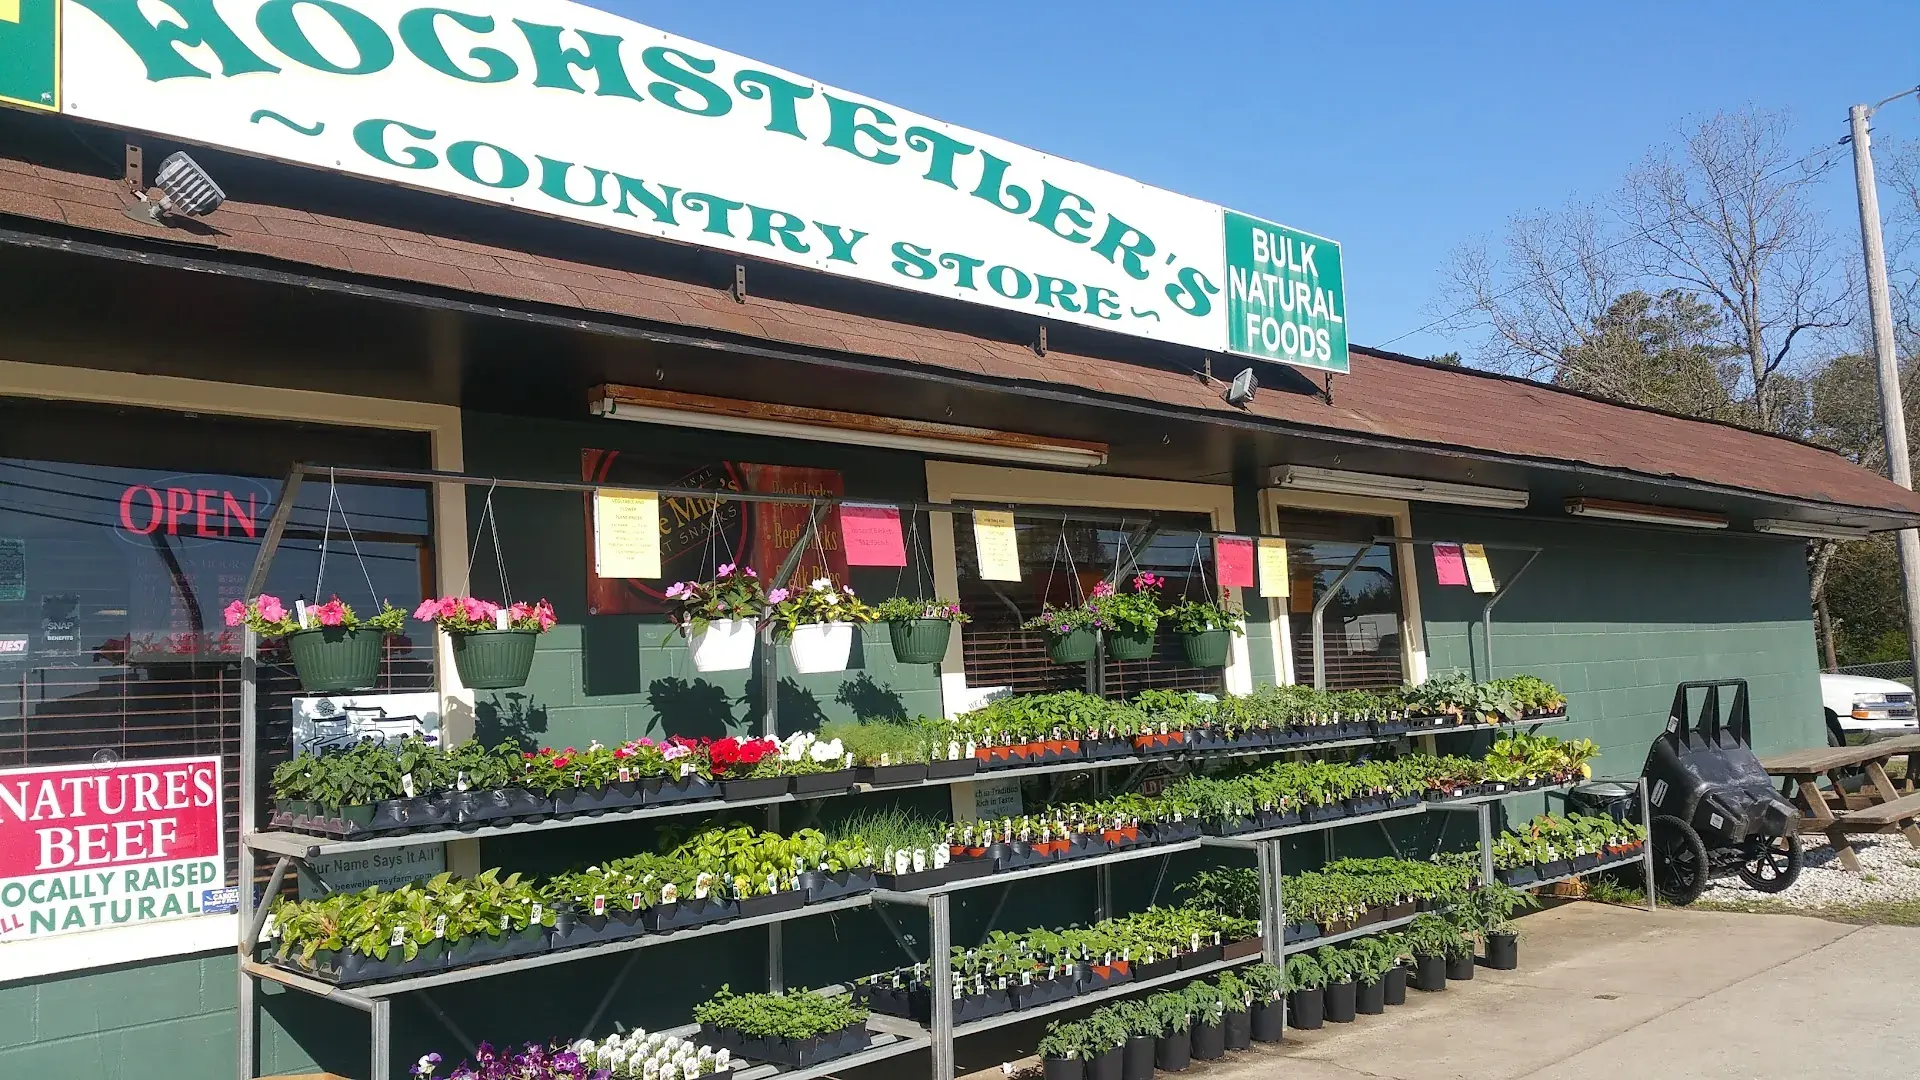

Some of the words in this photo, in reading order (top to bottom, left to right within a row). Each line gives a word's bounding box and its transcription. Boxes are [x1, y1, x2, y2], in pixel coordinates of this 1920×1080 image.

[66, 0, 1220, 317] HOCHSTETLER'S
[353, 119, 869, 266] COUNTRY
[891, 241, 1122, 322] STORE
[1252, 227, 1319, 278] BULK
[1230, 265, 1343, 323] NATURAL
[1247, 313, 1332, 361] FOODS
[120, 484, 255, 538] OPEN
[47, 621, 74, 630] SNAP
[0, 765, 214, 825] NATURE'S
[35, 817, 178, 870] BEEF
[334, 858, 369, 872] Name
[373, 853, 403, 869] Says
[407, 851, 415, 864] It
[1, 871, 116, 908] OCALLY
[124, 861, 217, 893] RAISED
[30, 891, 201, 934] NATURAL
